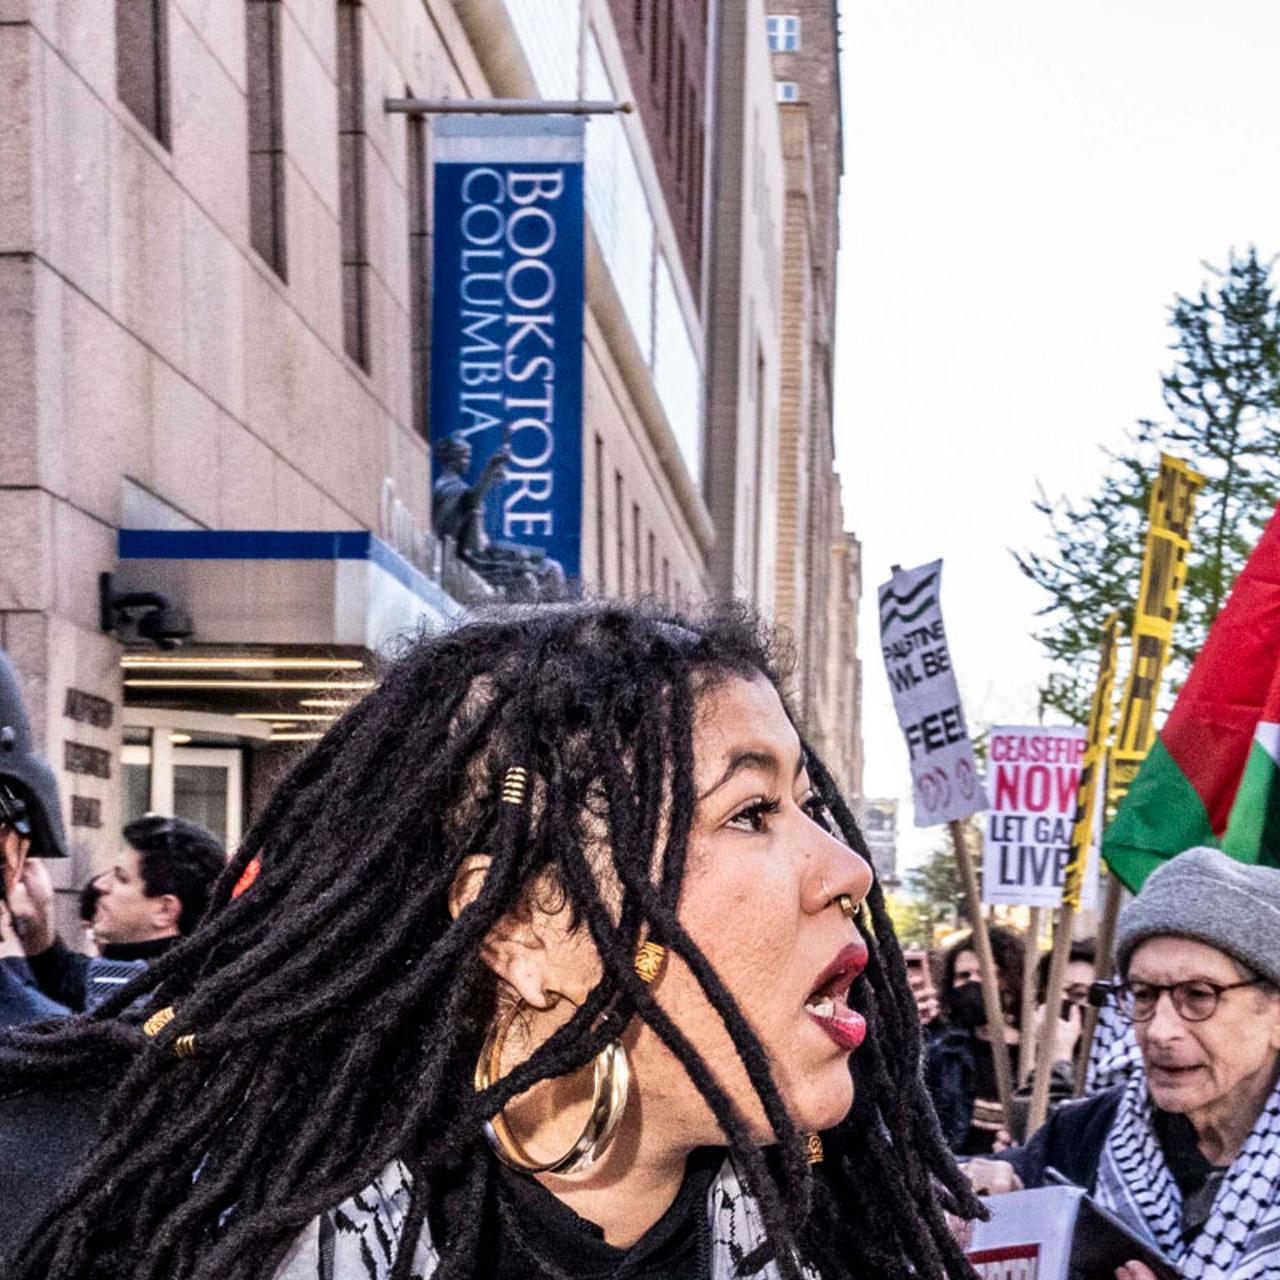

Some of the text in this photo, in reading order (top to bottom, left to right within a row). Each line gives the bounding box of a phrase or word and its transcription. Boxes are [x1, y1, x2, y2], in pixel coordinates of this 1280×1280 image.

[460, 168, 505, 438] COLUMBIA
[503, 170, 564, 538] BOOKSTORE
[922, 645, 951, 679] BE
[991, 735, 1089, 765] CEASEFIR
[990, 814, 1027, 843] LET
